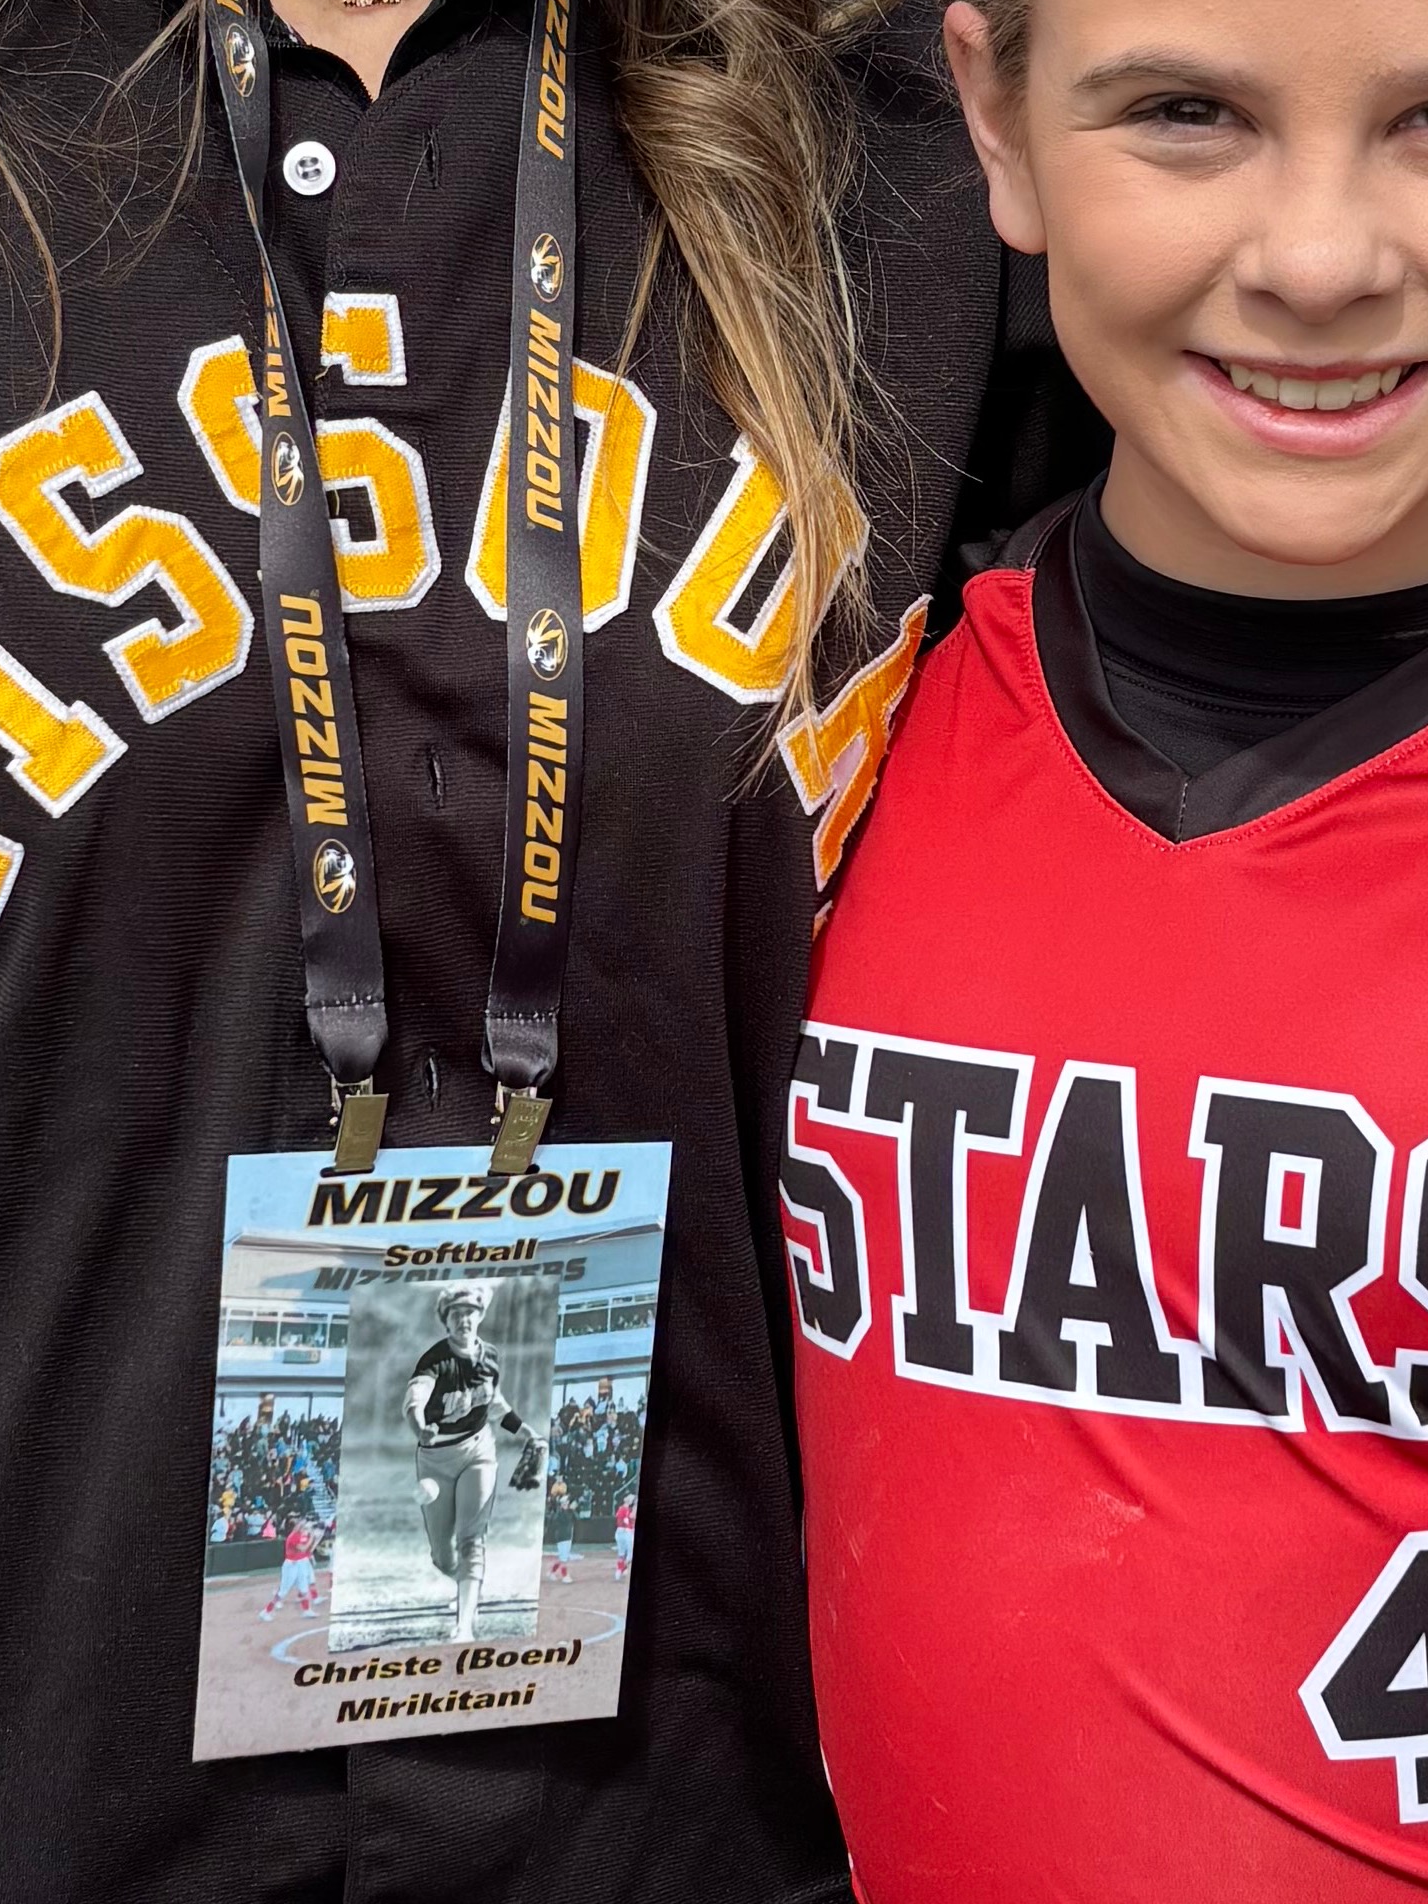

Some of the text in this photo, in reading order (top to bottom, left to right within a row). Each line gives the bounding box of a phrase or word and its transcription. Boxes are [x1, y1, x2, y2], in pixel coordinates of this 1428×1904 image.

[526, 307, 564, 532] MIZZOU
[279, 593, 348, 826] MIZZOU
[521, 690, 568, 924] MIZZOU
[307, 1169, 622, 1228] MIZZOU
[383, 1238, 539, 1267] Softball
[293, 1639, 583, 1688] Christe (Boen)
[336, 1682, 537, 1724] Mirikitani
